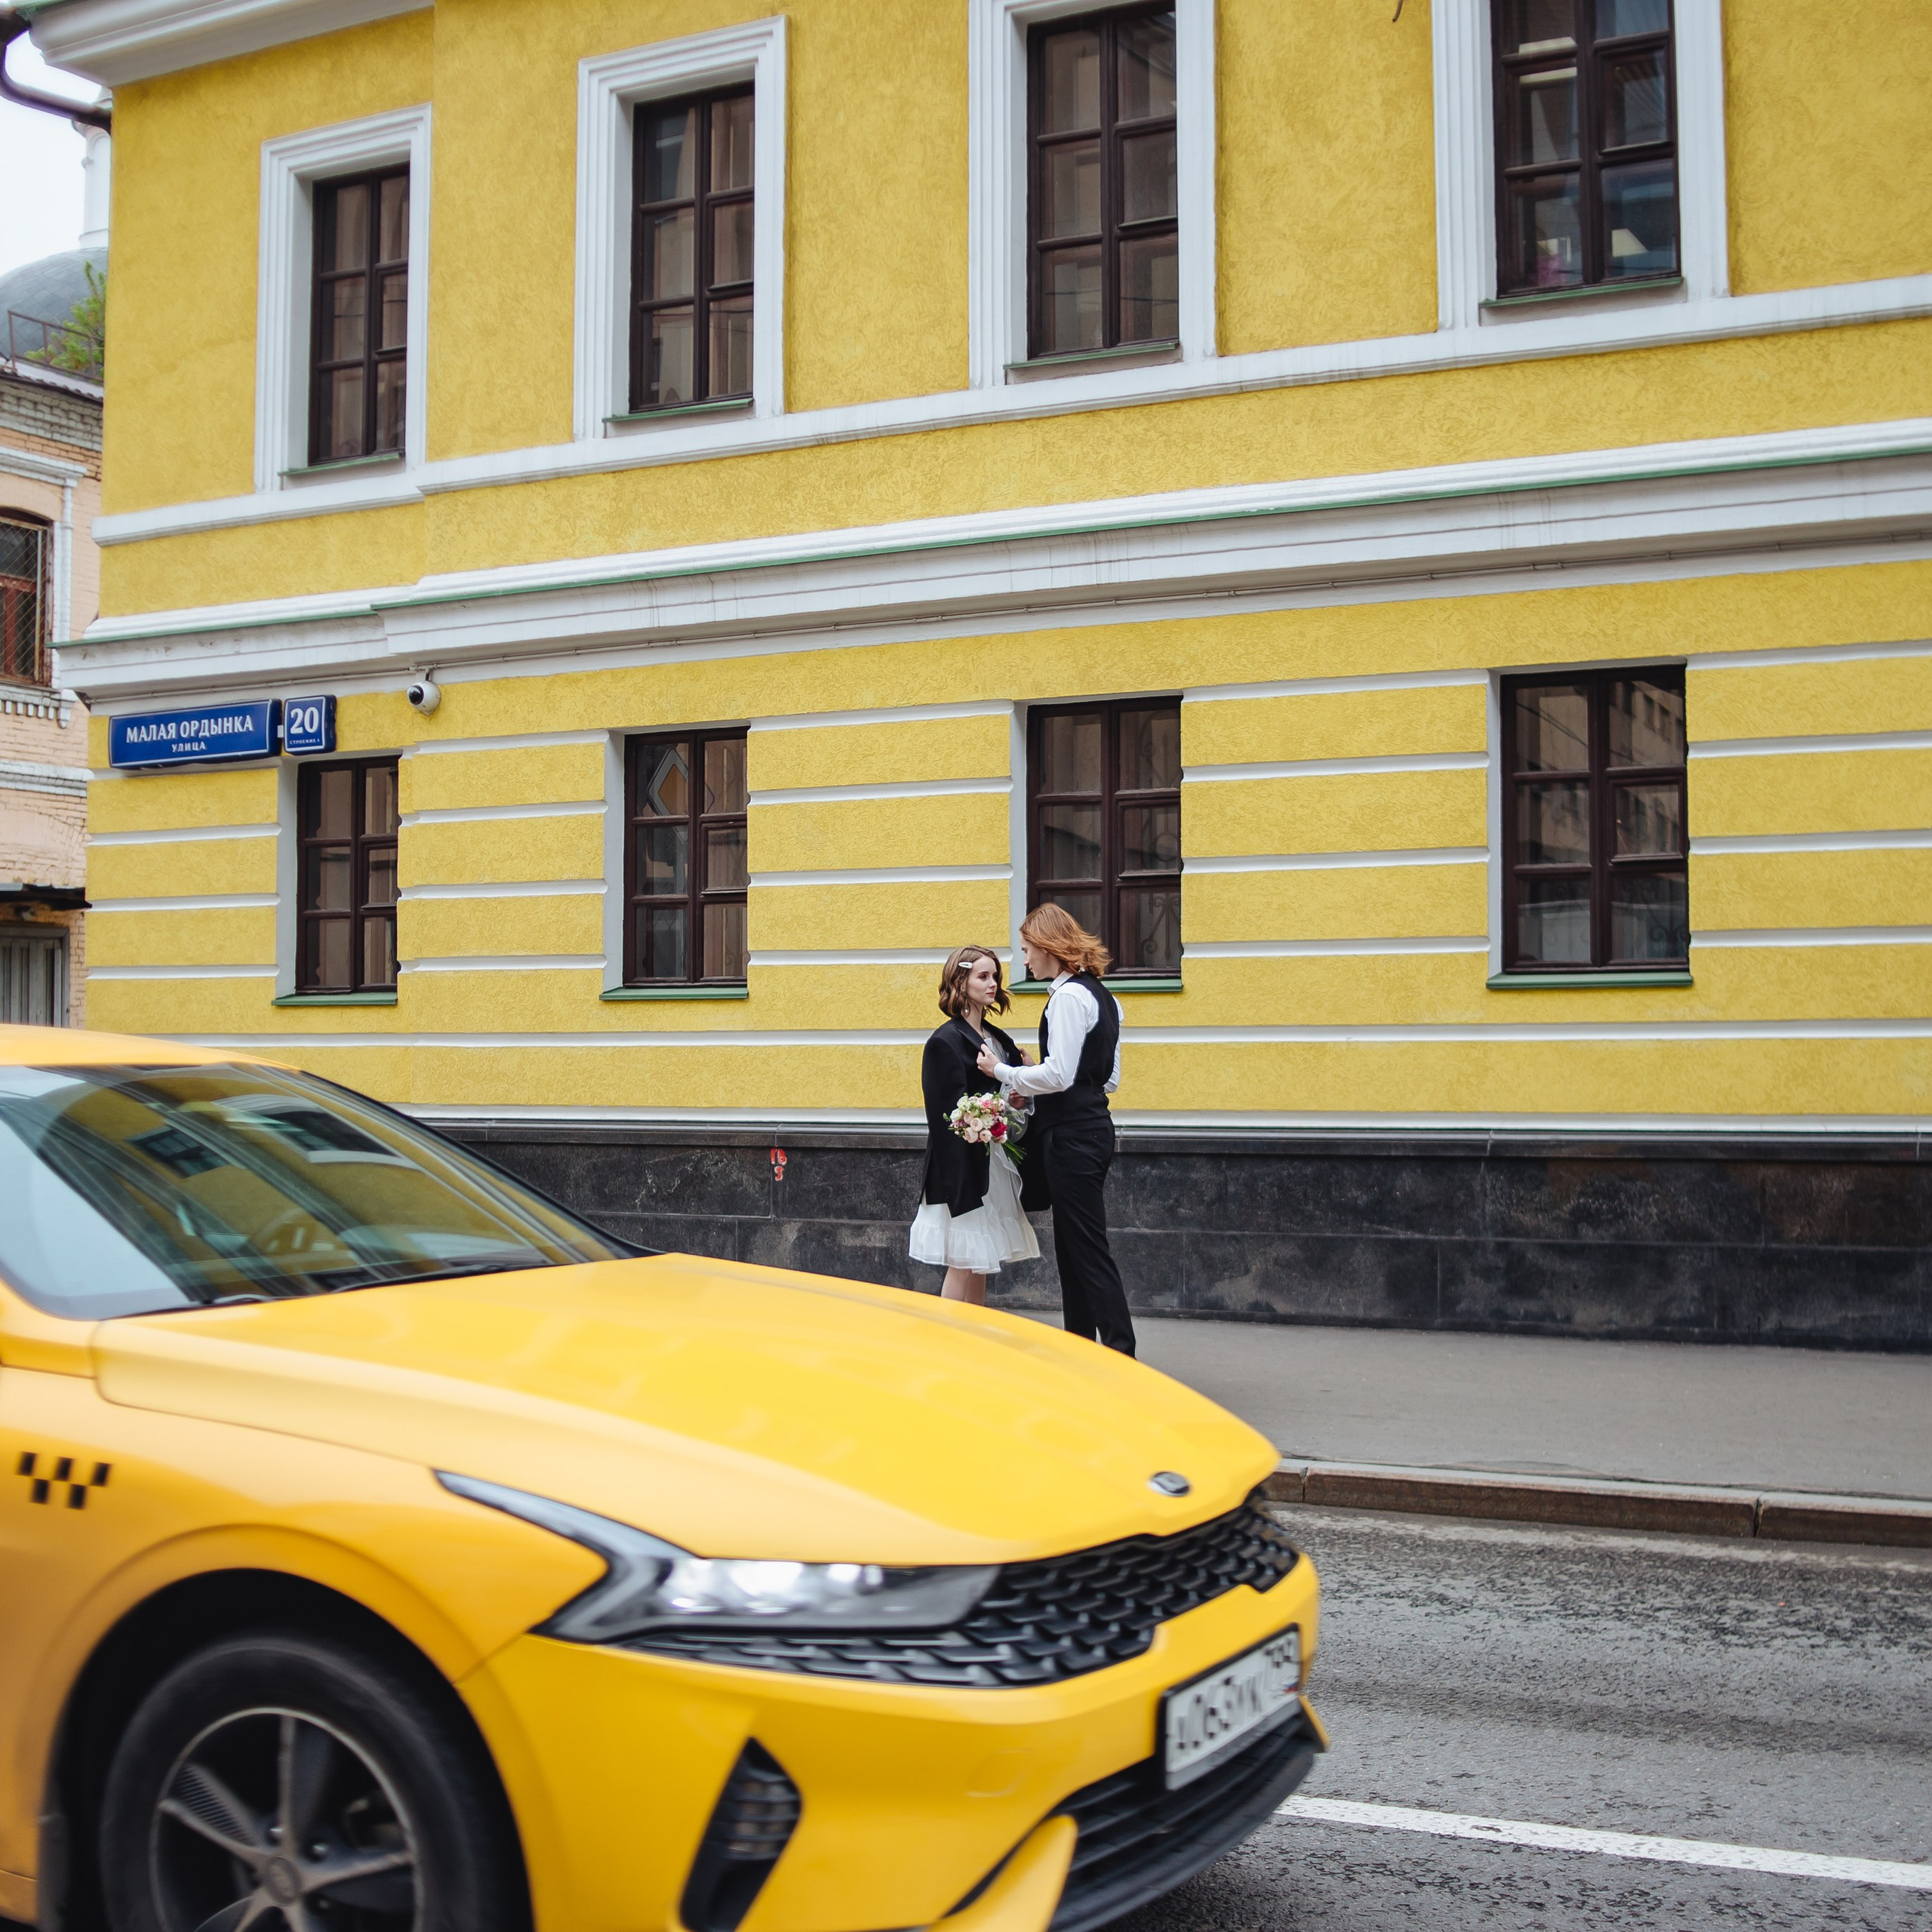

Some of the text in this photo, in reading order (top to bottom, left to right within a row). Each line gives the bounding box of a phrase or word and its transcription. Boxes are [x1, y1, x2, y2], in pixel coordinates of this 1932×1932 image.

[126, 715, 254, 743] МАЛАЯ ОРДЫНКА
[290, 706, 319, 734] 20
[171, 740, 206, 752] УЛИЦА
